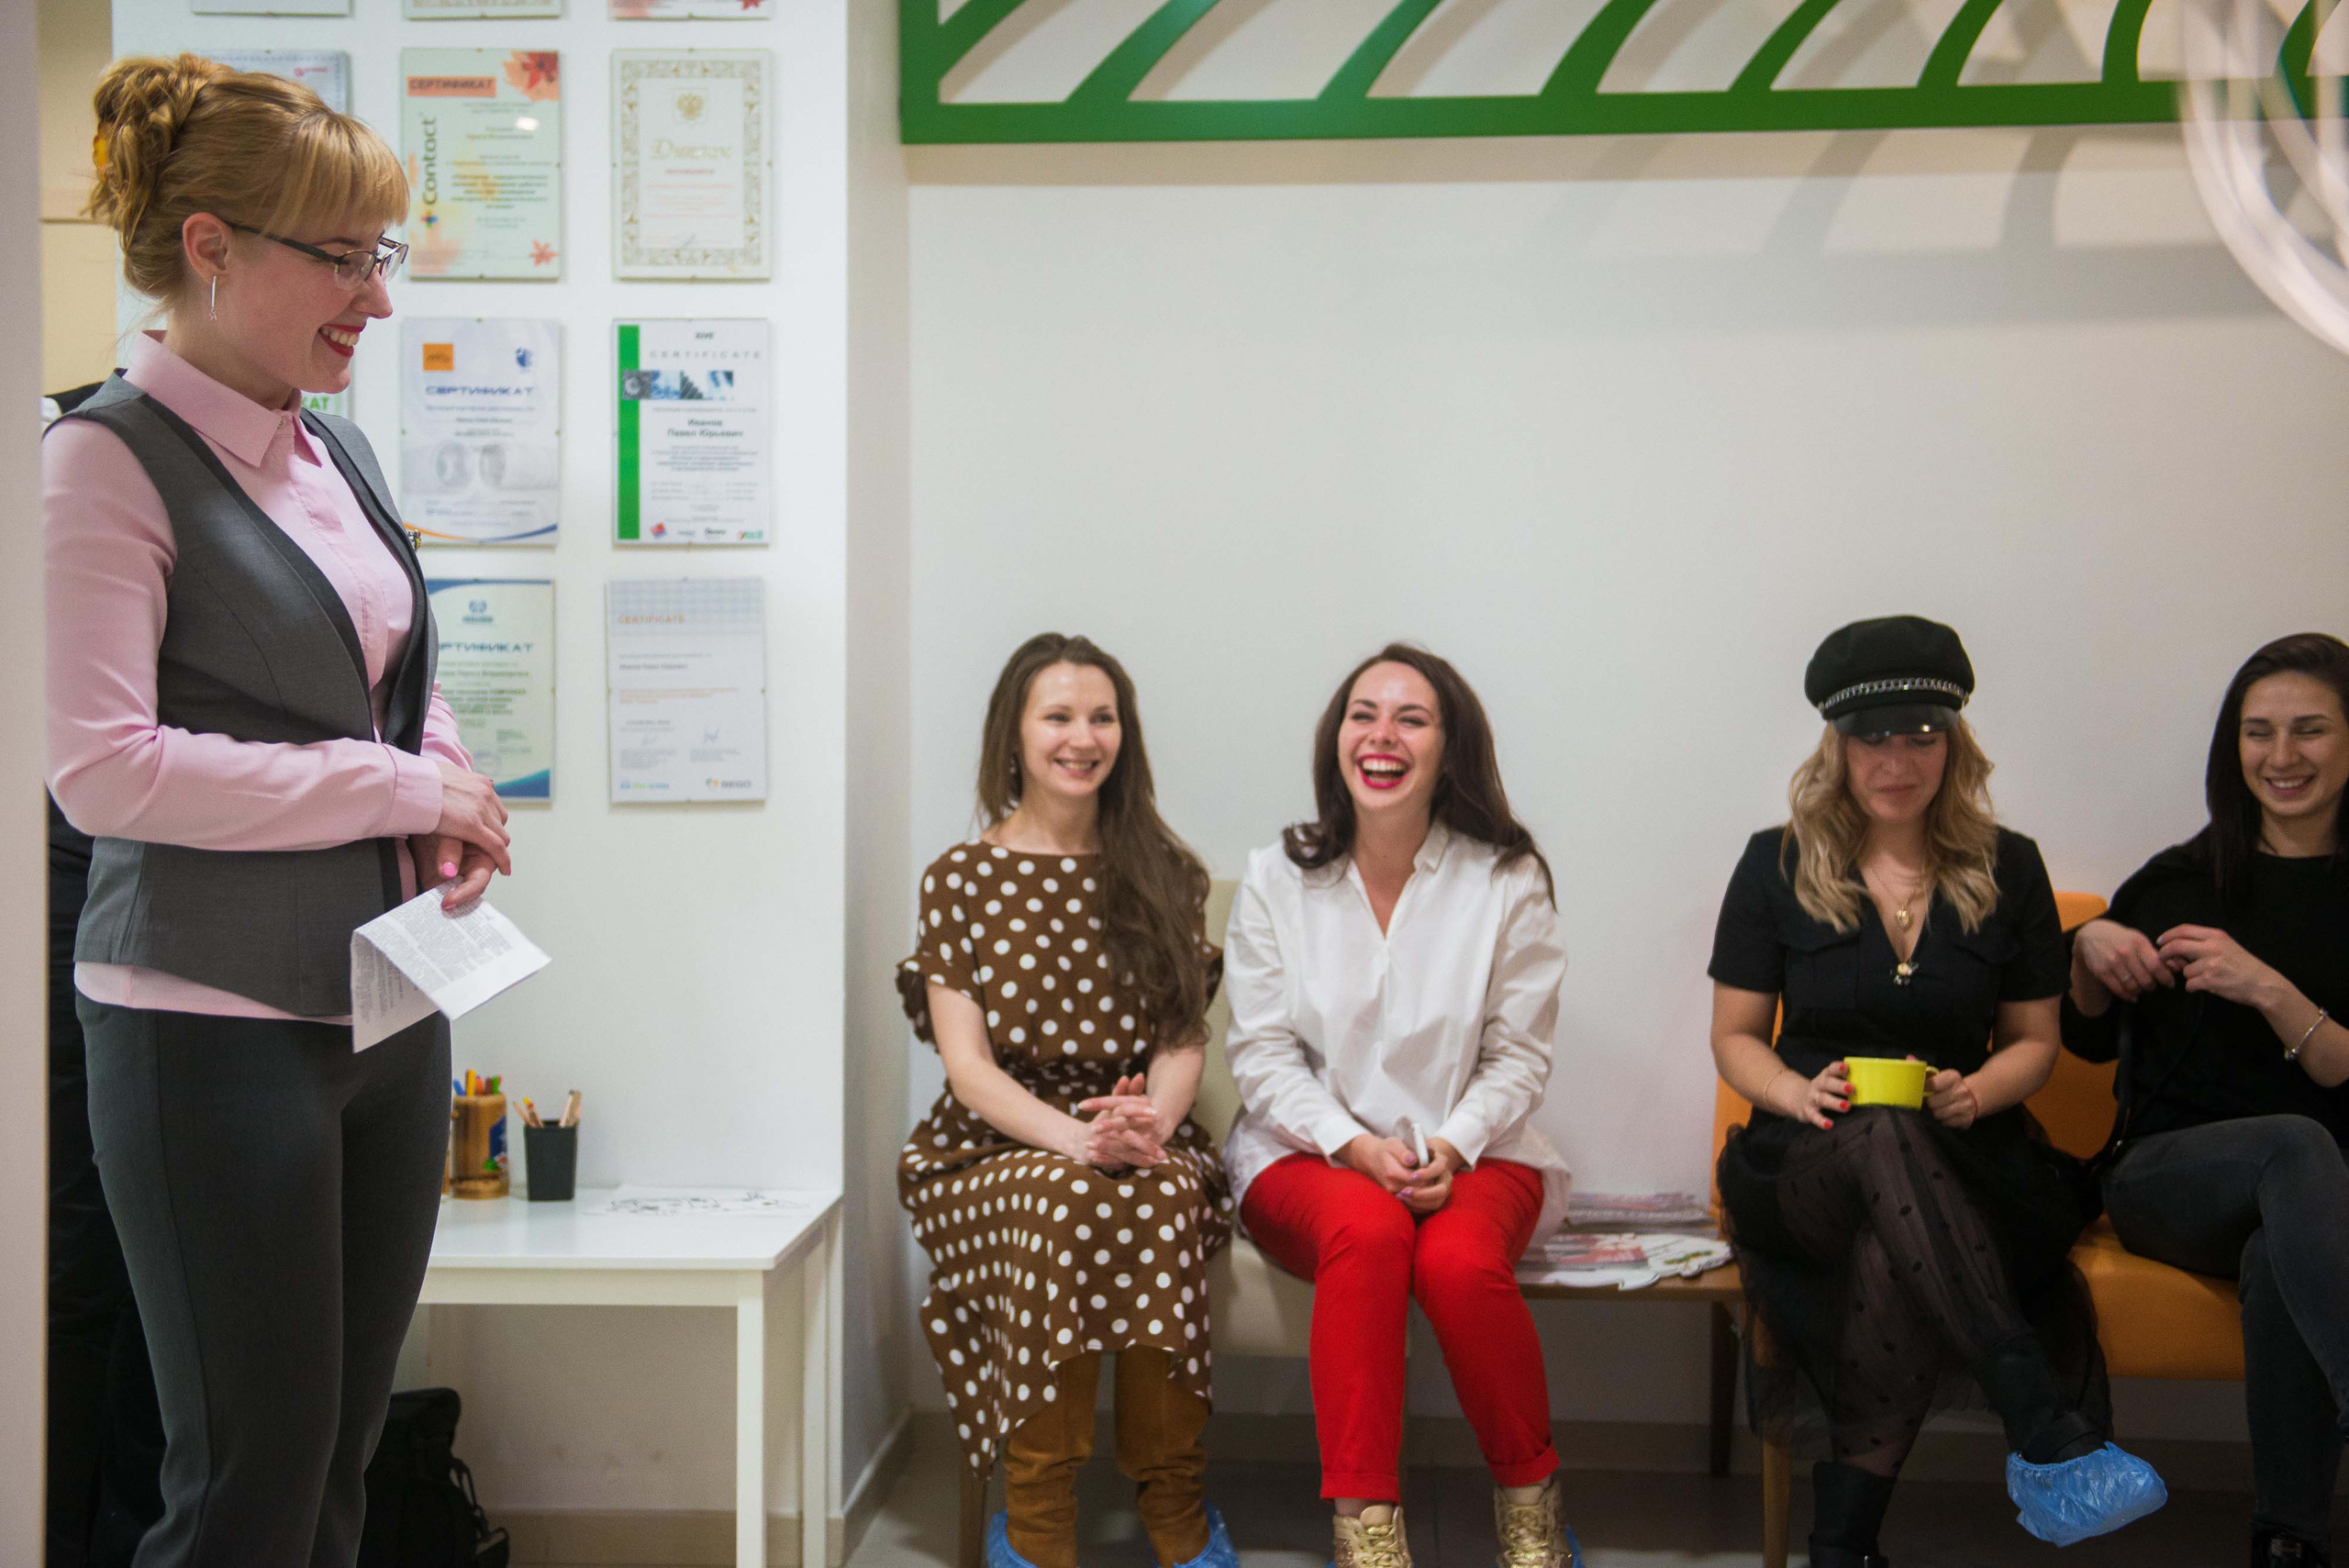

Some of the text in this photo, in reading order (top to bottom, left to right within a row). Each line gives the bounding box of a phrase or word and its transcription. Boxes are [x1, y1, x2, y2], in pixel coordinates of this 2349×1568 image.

[408, 79, 494, 90] СЕРТИФИКАТ
[422, 116, 438, 205] Contact
[650, 350, 762, 359] CERTIFICATE
[425, 385, 534, 395] СЕРТИФИКАТ
[688, 418, 723, 428] Иванов
[667, 428, 697, 438] Павел
[618, 615, 685, 625] CERTIFICATE
